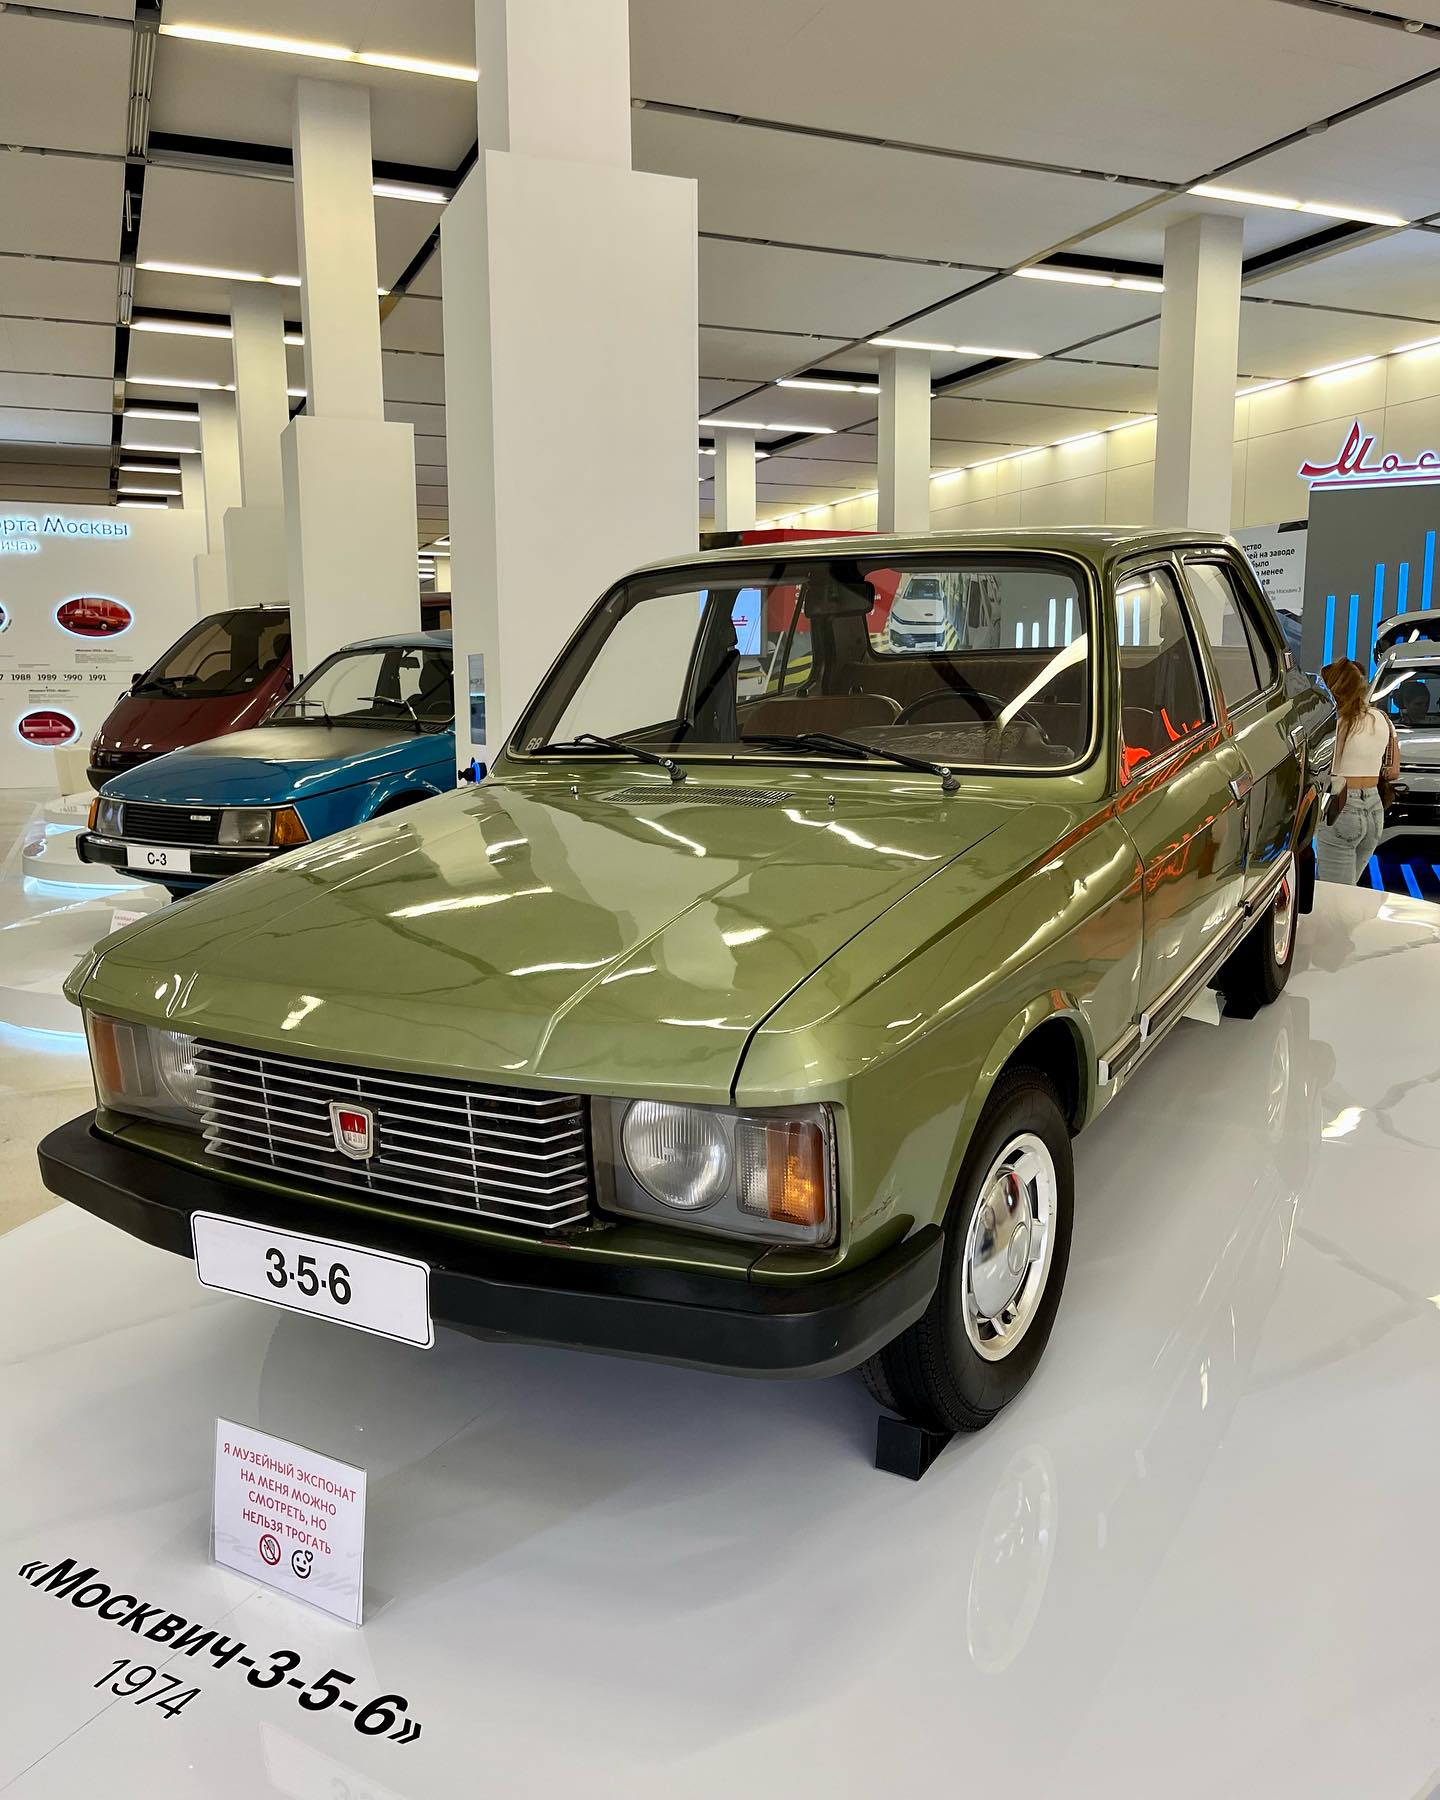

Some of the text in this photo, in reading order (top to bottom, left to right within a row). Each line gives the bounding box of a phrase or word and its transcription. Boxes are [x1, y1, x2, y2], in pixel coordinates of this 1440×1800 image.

[0, 517, 128, 535] рта Москвы
[1269, 548, 1295, 556] заводе
[224, 1443, 356, 1502] Я МУЗЕЙНЫЙ ЭКСПОНАТ
[241, 1468, 337, 1516] НА МЕНЯ МОЖНО
[243, 1508, 331, 1554] НЕЛЬЗЯ ТРОГАТЬ
[248, 1491, 327, 1531] СМОТРЕТЬ, НО
[93, 1658, 202, 1720] 1974
